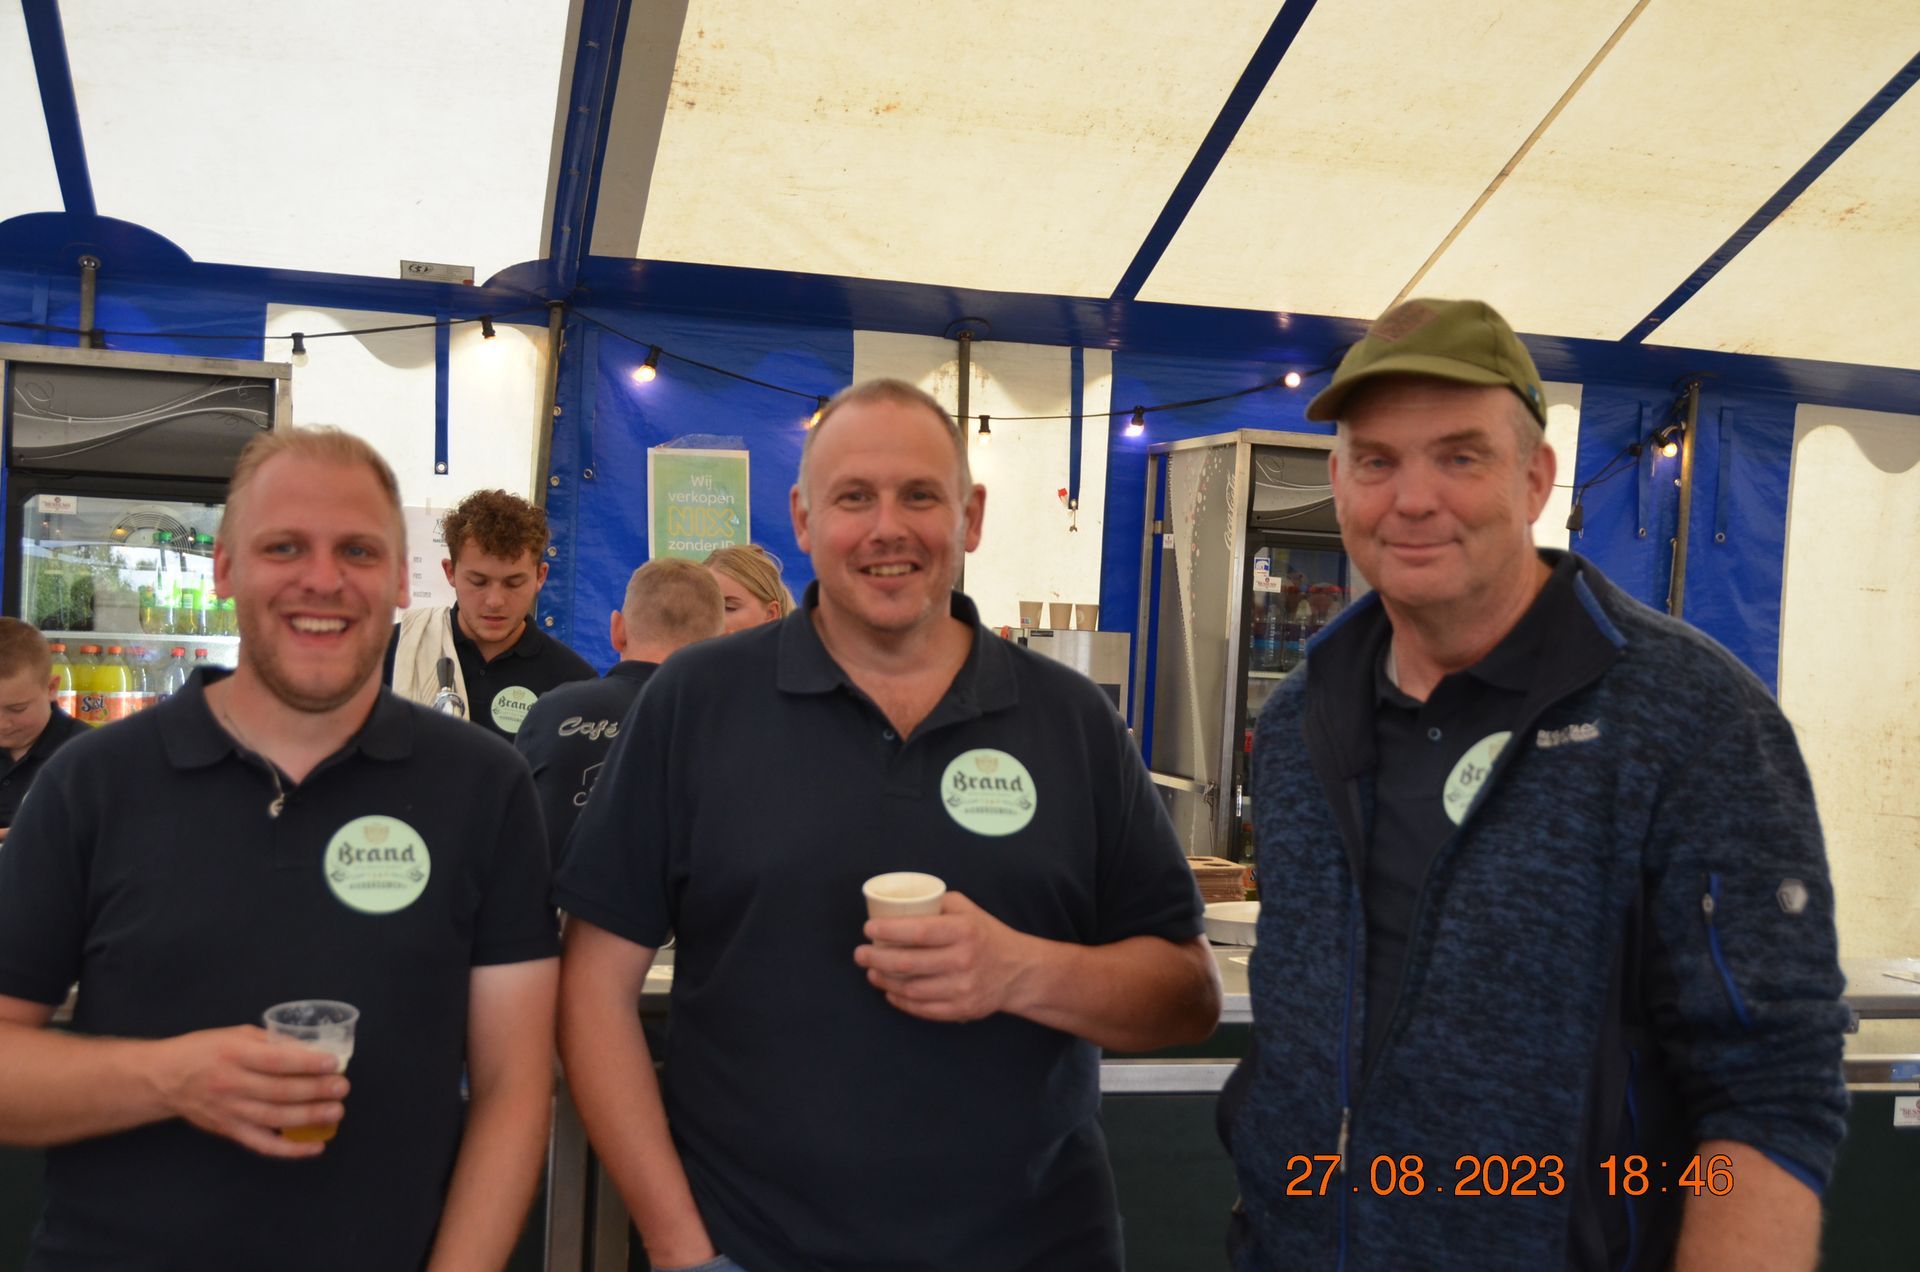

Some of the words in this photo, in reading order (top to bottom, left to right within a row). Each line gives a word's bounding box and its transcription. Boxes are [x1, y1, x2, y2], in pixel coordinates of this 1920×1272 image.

[691, 475, 712, 490] Wij
[668, 490, 735, 506] verkopen
[667, 505, 736, 538] NIX
[668, 539, 717, 551] zonder
[558, 716, 620, 740] Café
[953, 770, 1024, 792] Brand
[338, 841, 416, 866] Brand
